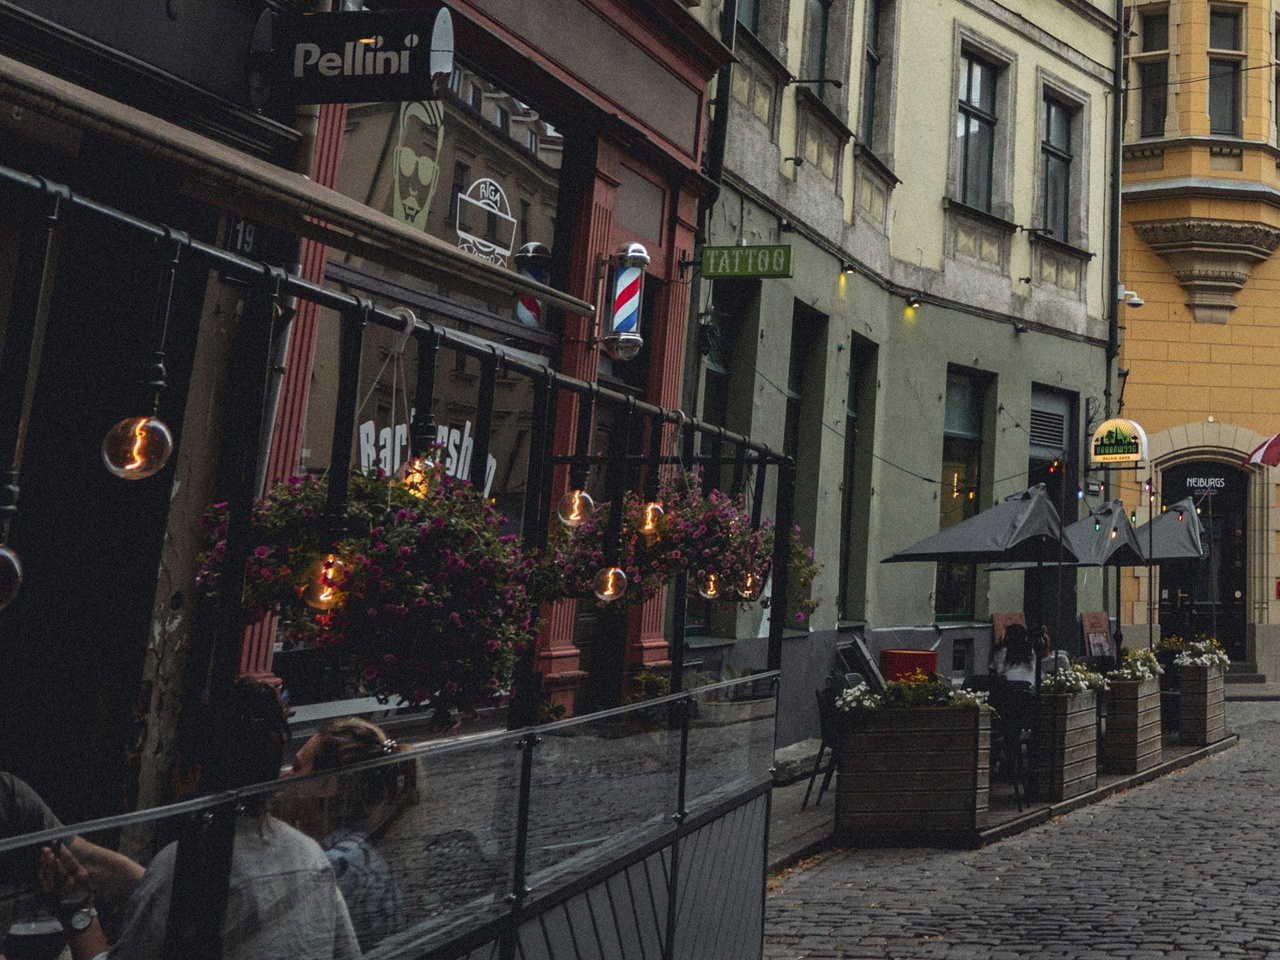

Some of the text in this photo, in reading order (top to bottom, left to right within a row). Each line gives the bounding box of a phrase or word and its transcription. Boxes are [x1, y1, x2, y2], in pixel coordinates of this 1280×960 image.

[293, 34, 419, 78] Pellini
[236, 220, 255, 252] 19
[706, 248, 785, 273] TATTOO
[1187, 477, 1226, 488] NEIBURGS
